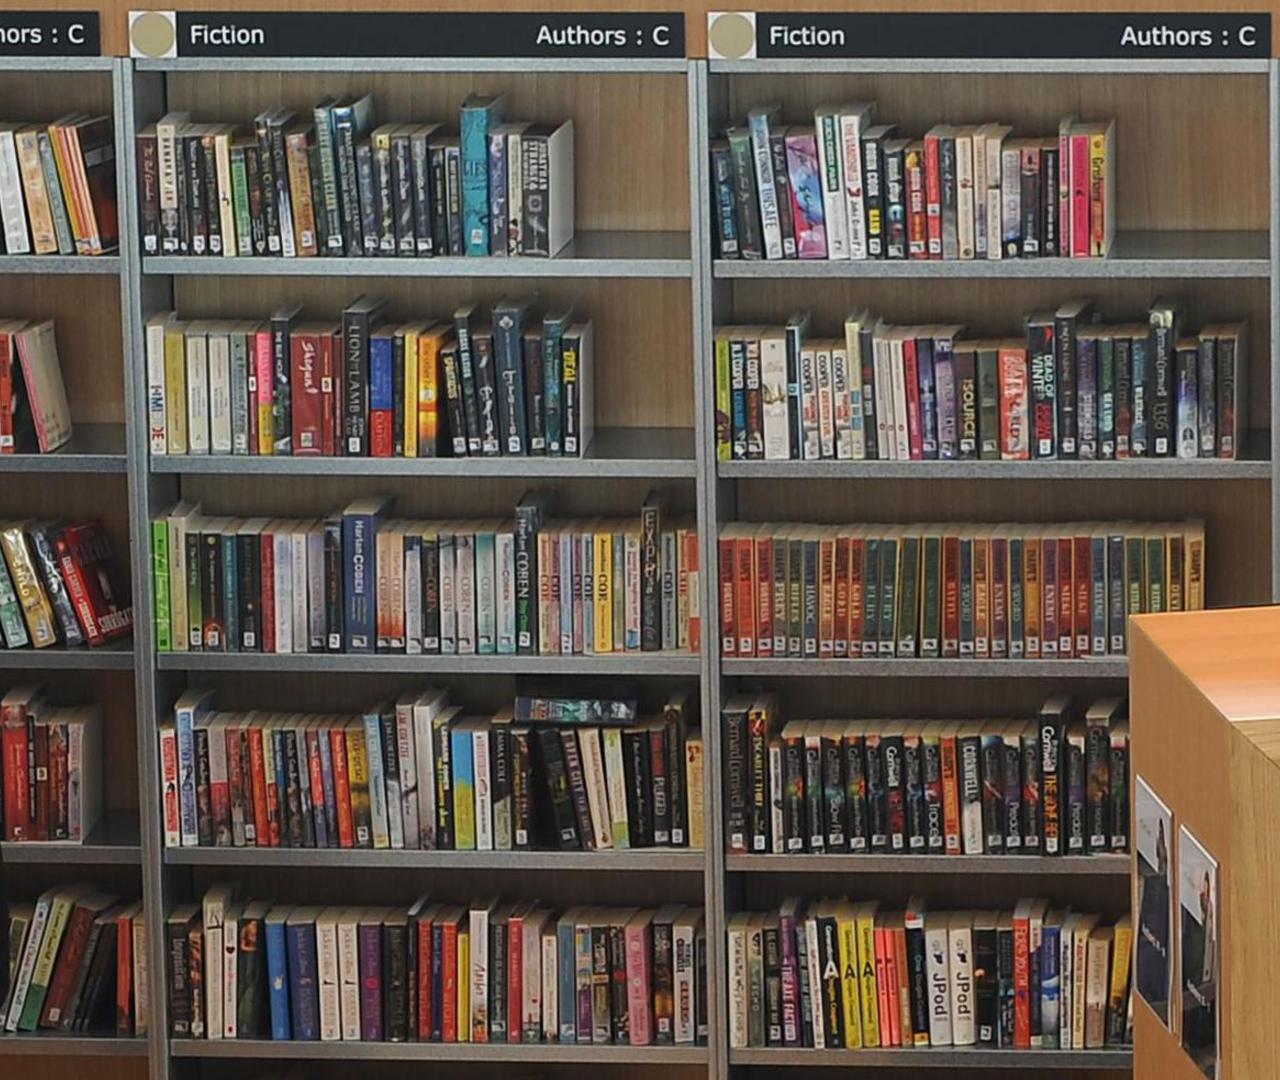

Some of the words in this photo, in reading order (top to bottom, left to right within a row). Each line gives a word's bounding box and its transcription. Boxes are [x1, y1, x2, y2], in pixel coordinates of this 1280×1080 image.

[68, 24, 85, 44] C
[190, 24, 265, 45] Fiction
[536, 25, 627, 46] Authors
[652, 26, 670, 46] C
[770, 25, 845, 46] Fiction
[1120, 26, 1213, 46] Authors
[1238, 26, 1256, 46] C
[756, 129, 769, 152] JOHN
[758, 153, 772, 184] CONNOR
[762, 188, 778, 228] UNSAFE
[348, 326, 361, 362] LION
[563, 352, 576, 384] DEAL
[834, 357, 845, 393] COOPER
[349, 371, 361, 413] LAMB
[963, 385, 975, 438] SOURCE
[353, 520, 364, 554] Harlan
[353, 555, 365, 593] COBEN
[517, 552, 529, 597] COBEN
[774, 583, 784, 621] PREY
[806, 586, 815, 623] HAVOC
[957, 972, 971, 1015] JPod
